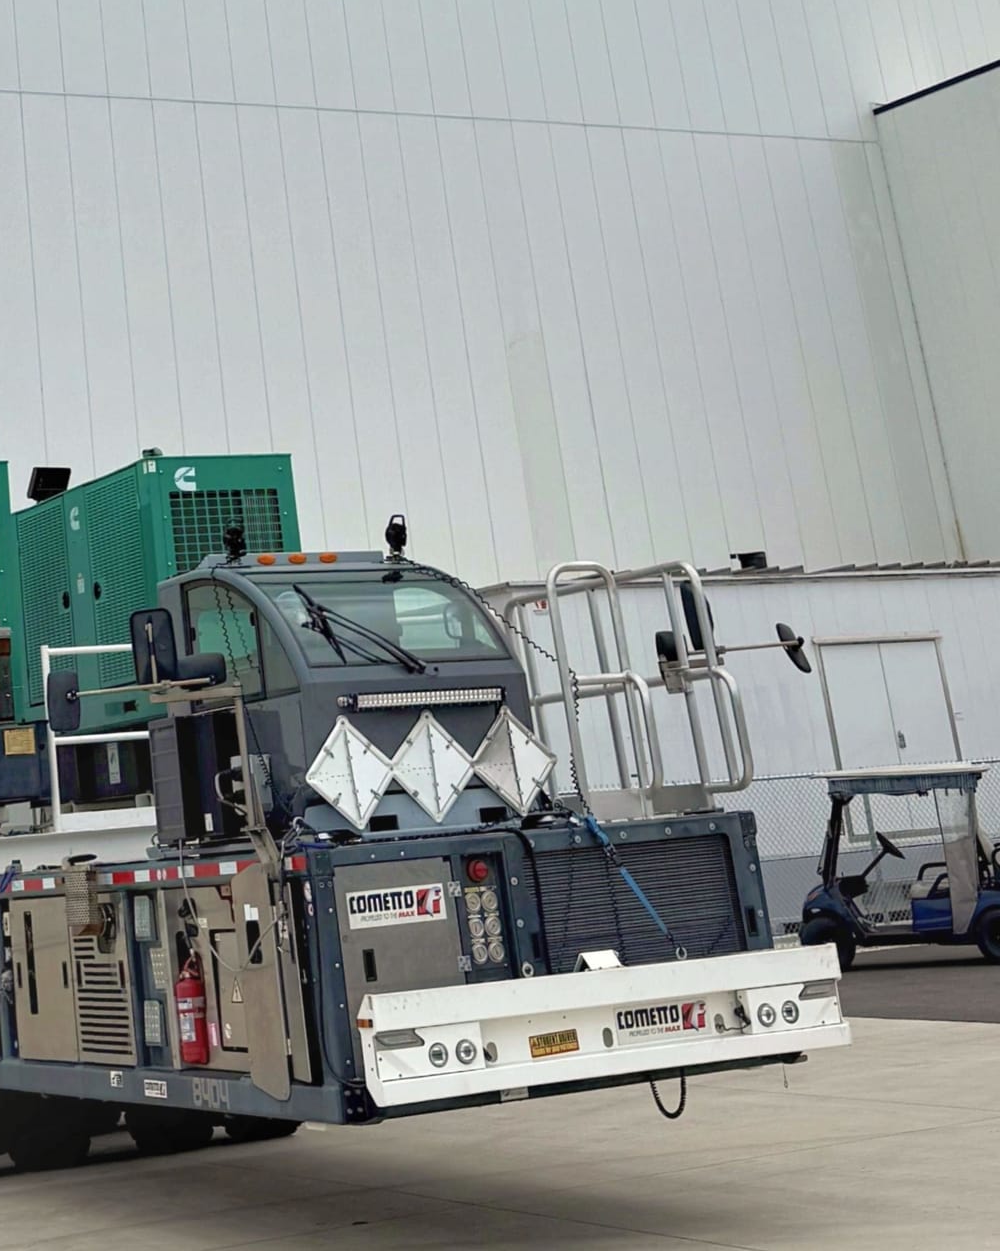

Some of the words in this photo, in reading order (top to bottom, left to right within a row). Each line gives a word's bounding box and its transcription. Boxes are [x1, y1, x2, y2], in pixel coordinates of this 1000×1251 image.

[348, 890, 414, 915] COMETTO
[398, 910, 415, 918] MAX
[616, 1004, 680, 1030] COMETTO
[664, 1025, 681, 1033] MAX
[192, 1076, 230, 1110] 8404
